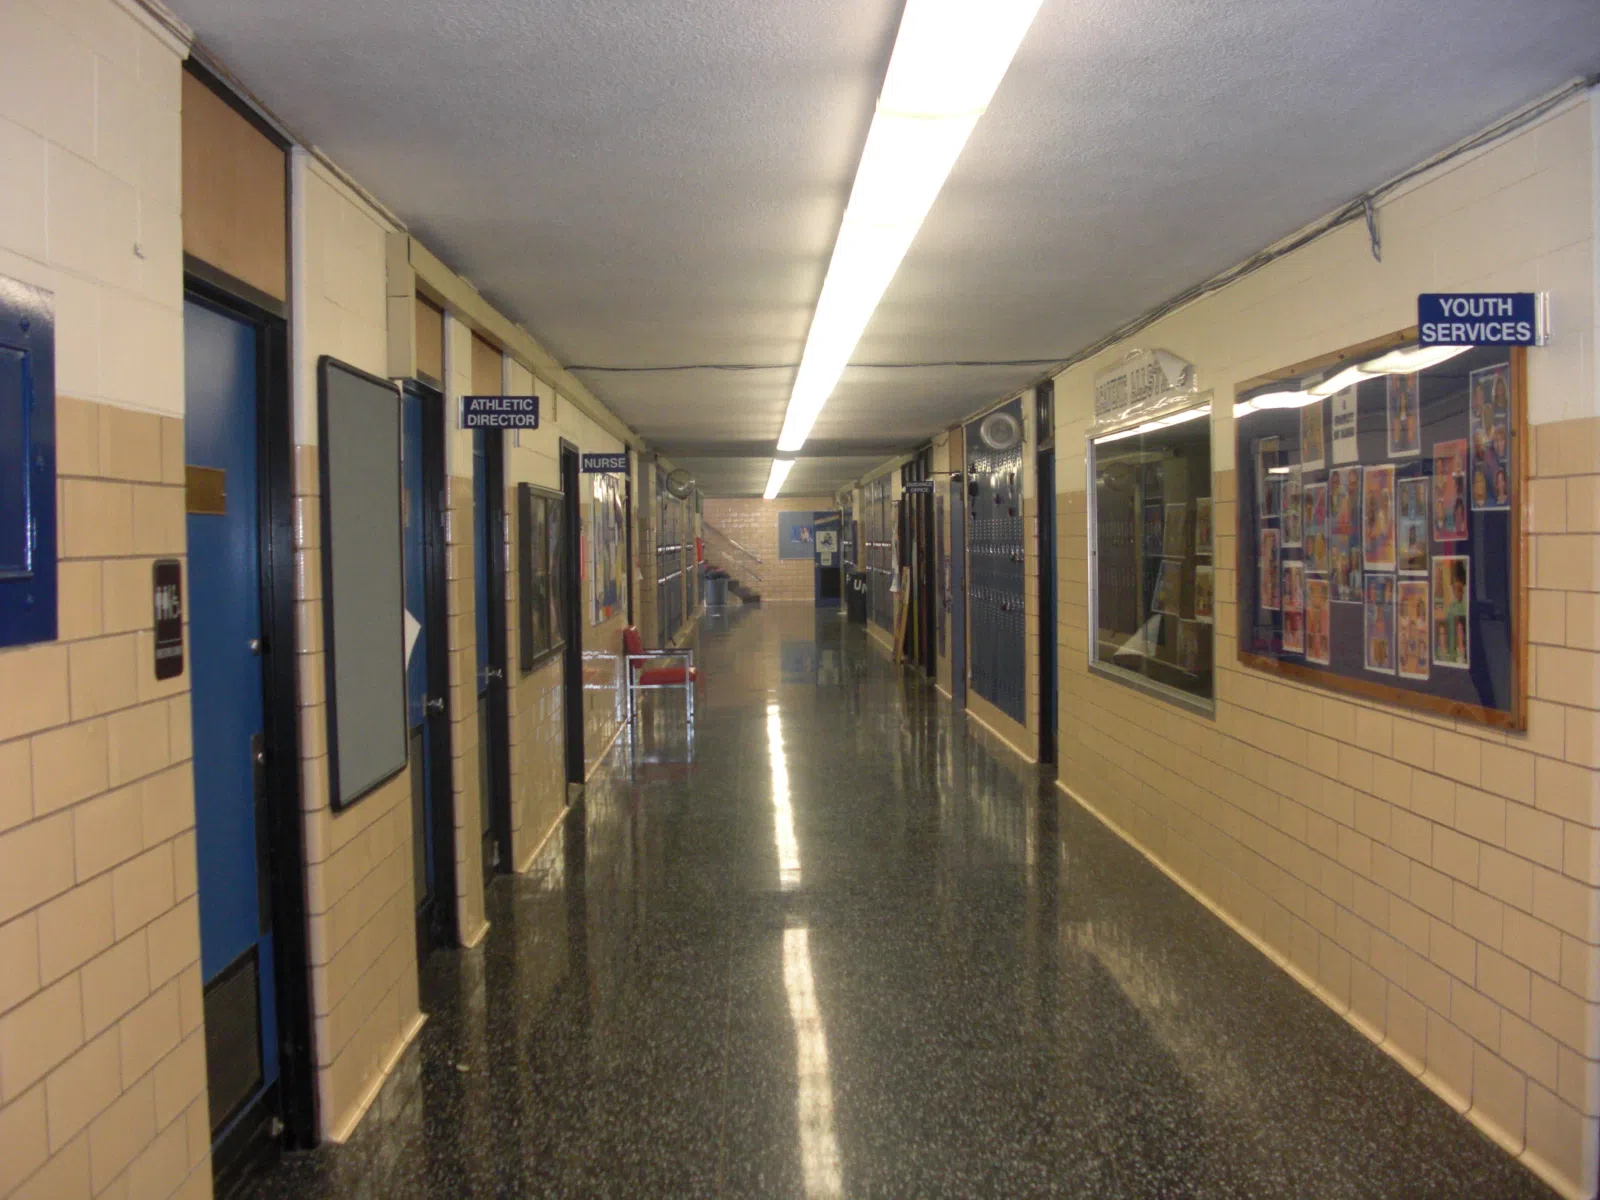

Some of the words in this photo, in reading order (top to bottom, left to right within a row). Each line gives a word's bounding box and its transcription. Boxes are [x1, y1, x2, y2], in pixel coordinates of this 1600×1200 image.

[1439, 297, 1513, 317] YOUTH
[1421, 321, 1532, 343] SERVICES
[470, 398, 534, 411] ATHLETIC
[467, 414, 536, 427] DIRECTOR
[583, 457, 626, 469] NURSE
